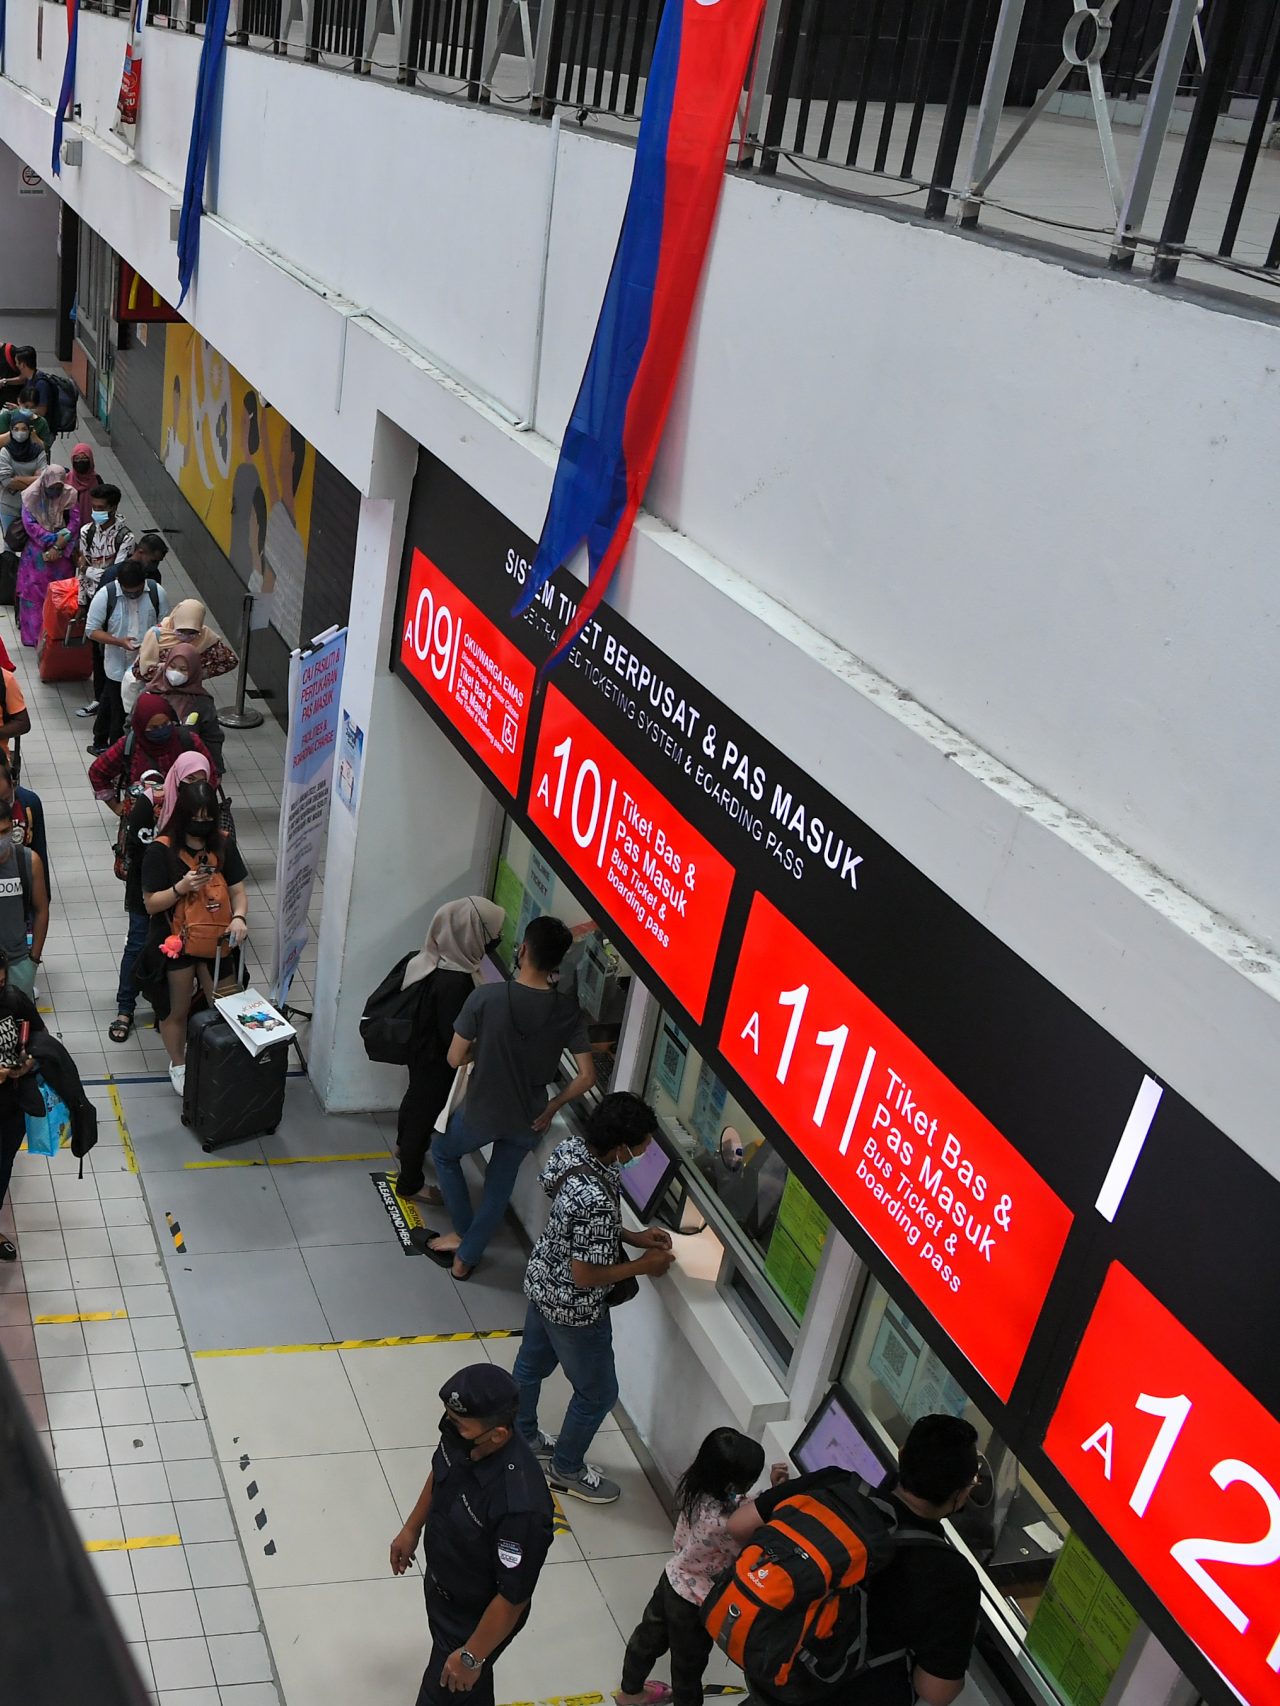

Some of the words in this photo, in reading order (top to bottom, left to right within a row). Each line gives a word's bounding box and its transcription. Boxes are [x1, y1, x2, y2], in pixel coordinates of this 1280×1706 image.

[301, 703, 313, 723] PAS
[313, 689, 334, 716] MASUK
[455, 692, 464, 707] Bus
[456, 678, 469, 699] Pas
[469, 693, 489, 723] Masuk
[459, 662, 474, 688] Tiket
[473, 678, 486, 703] Bas
[486, 695, 492, 711] &
[463, 633, 503, 686] OKU/WARGA
[503, 674, 524, 709] EMAS
[584, 657, 637, 720] TICKETING
[637, 709, 684, 765] SYSTEM
[684, 754, 693, 776] &
[765, 830, 804, 881] PASS
[603, 634, 701, 738] BERPUSAT
[702, 724, 717, 759] &
[721, 740, 766, 801] PAS
[769, 783, 865, 891] MASUK
[615, 819, 640, 863] Pas
[642, 850, 688, 918] Masuk
[622, 791, 654, 844] Tiket
[654, 828, 682, 875] Bas
[684, 863, 696, 891] &
[607, 867, 646, 923] boarding
[644, 915, 670, 949] pass
[610, 848, 629, 878] Bus
[630, 868, 657, 911] Ticket
[657, 902, 667, 921] &
[871, 1102, 914, 1166] Pas
[918, 1154, 997, 1263] Masuk
[886, 1066, 938, 1147] Tiket
[940, 1132, 988, 1202] Bas
[993, 1194, 1013, 1232] &
[376, 1181, 395, 1206] PLEASE
[387, 1204, 405, 1230] STAND
[398, 1227, 412, 1246] HERE
[855, 1158, 922, 1247] boarding
[920, 1241, 962, 1293] pass
[862, 1136, 893, 1179] Bus
[896, 1171, 945, 1237] Ticket
[944, 1232, 958, 1257] &
[747, 1572, 765, 1589] deuter
